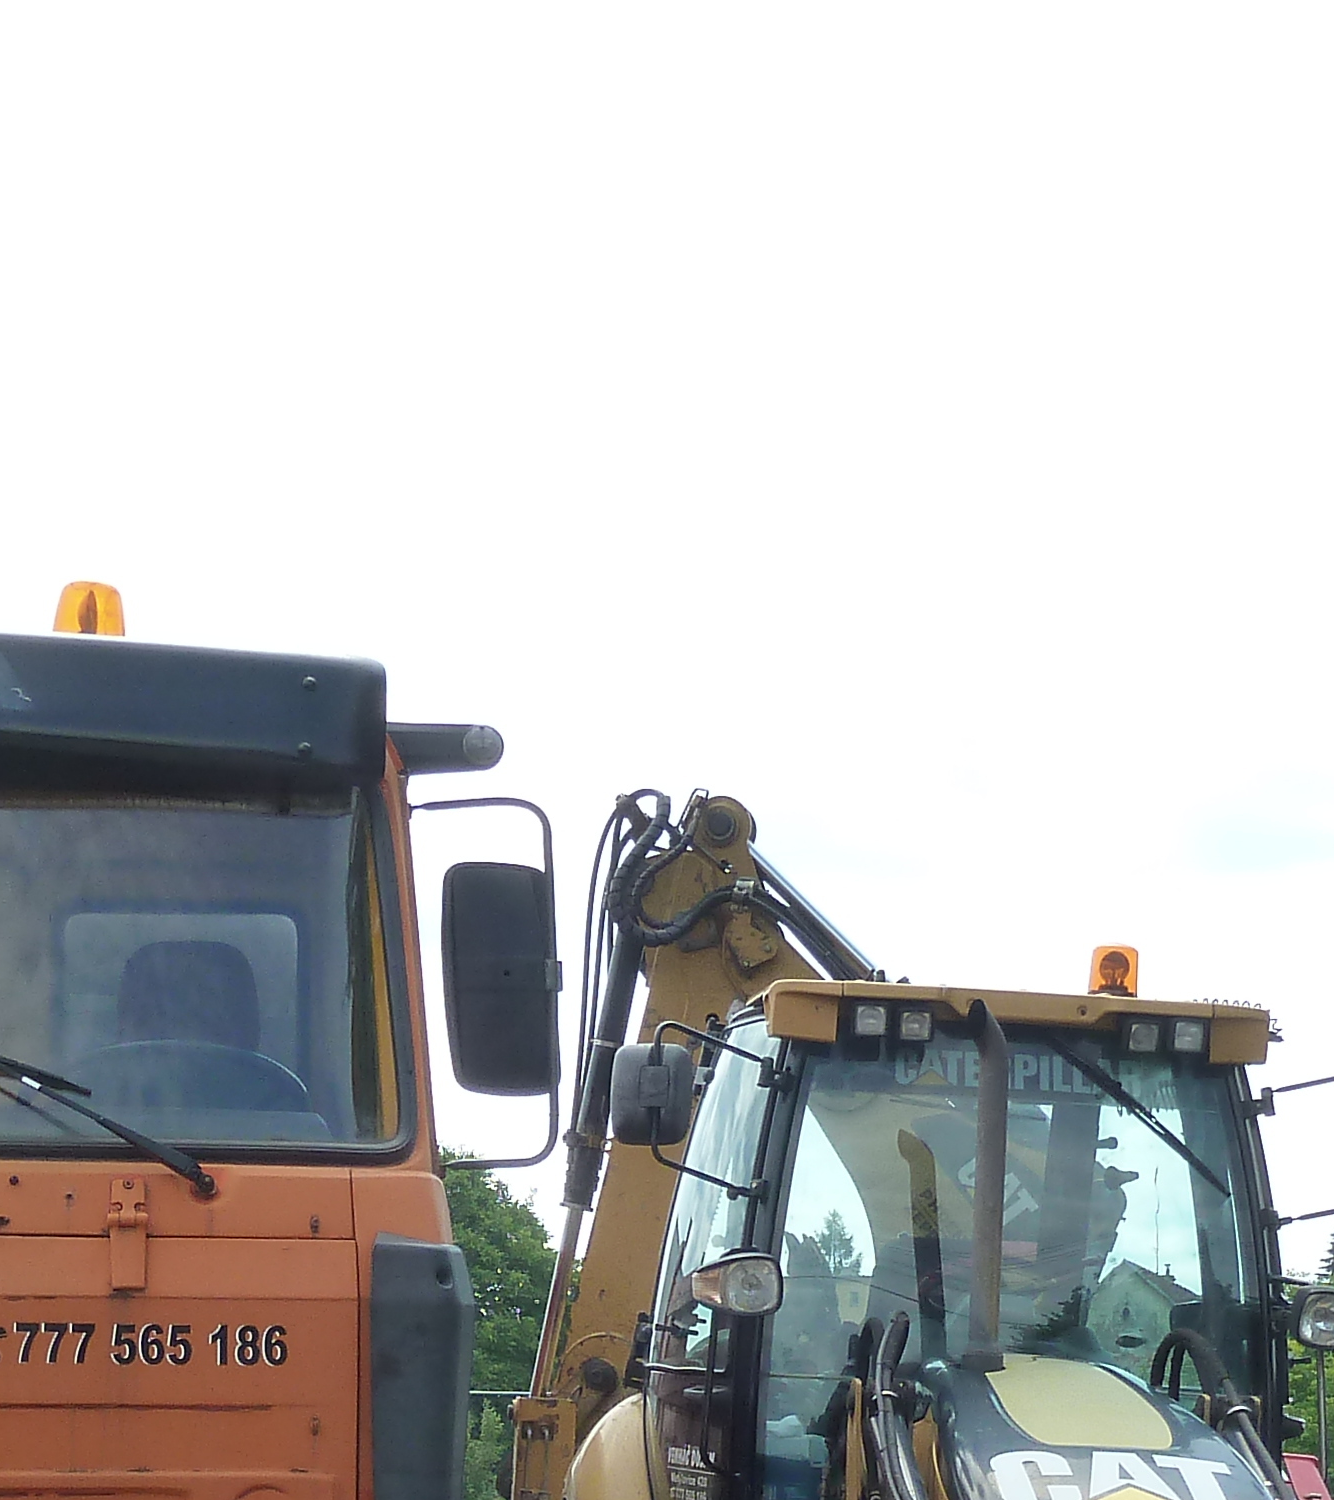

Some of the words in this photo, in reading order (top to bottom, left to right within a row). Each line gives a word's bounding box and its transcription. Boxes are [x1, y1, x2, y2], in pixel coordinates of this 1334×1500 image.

[13, 1322, 95, 1365] 777
[110, 1323, 192, 1366] 565
[208, 1324, 289, 1367] 186
